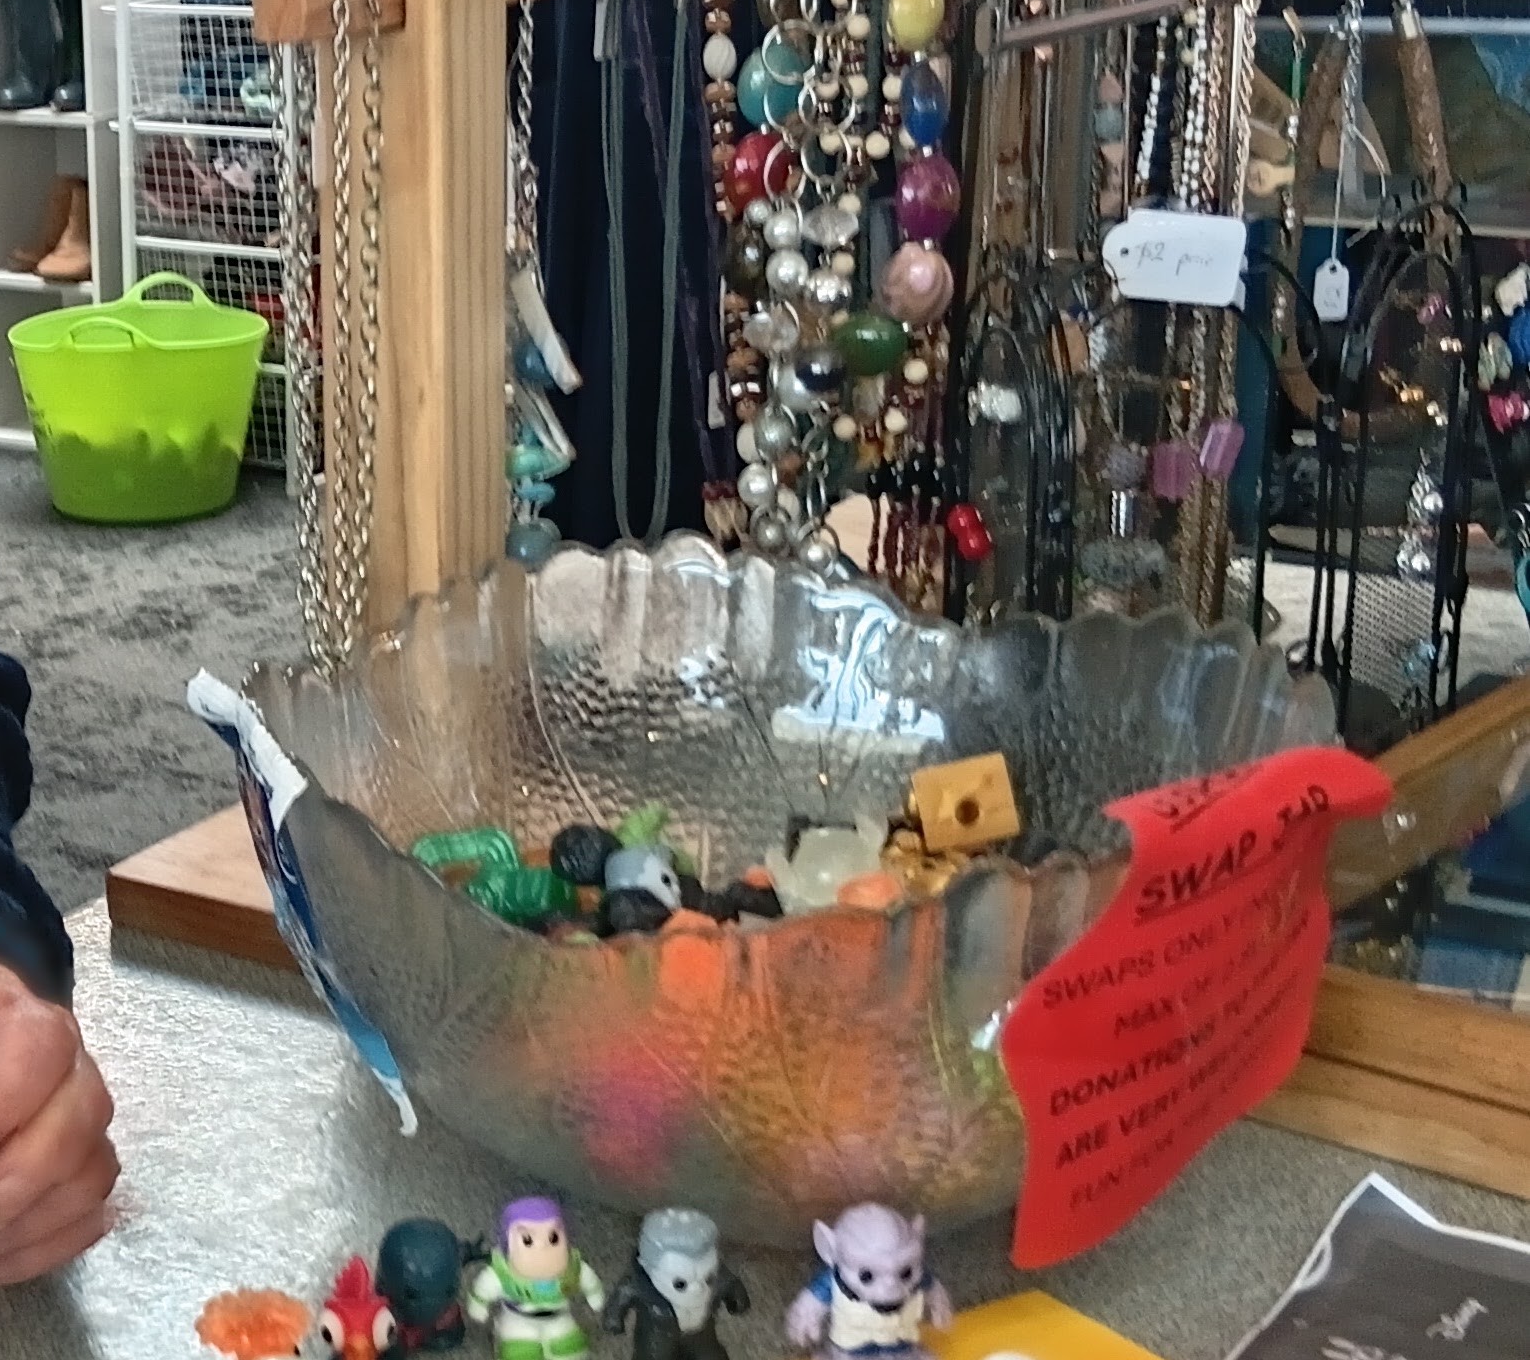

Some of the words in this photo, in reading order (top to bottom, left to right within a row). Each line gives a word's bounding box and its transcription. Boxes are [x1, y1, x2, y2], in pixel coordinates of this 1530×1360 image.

[1134, 829, 1257, 920] SWAP
[1042, 949, 1155, 1010] SWAPS
[1113, 995, 1175, 1040] MAX
[1050, 1016, 1217, 1118] DONATIONS
[1056, 1120, 1112, 1170] ARE
[1117, 1086, 1180, 1138] VERY
